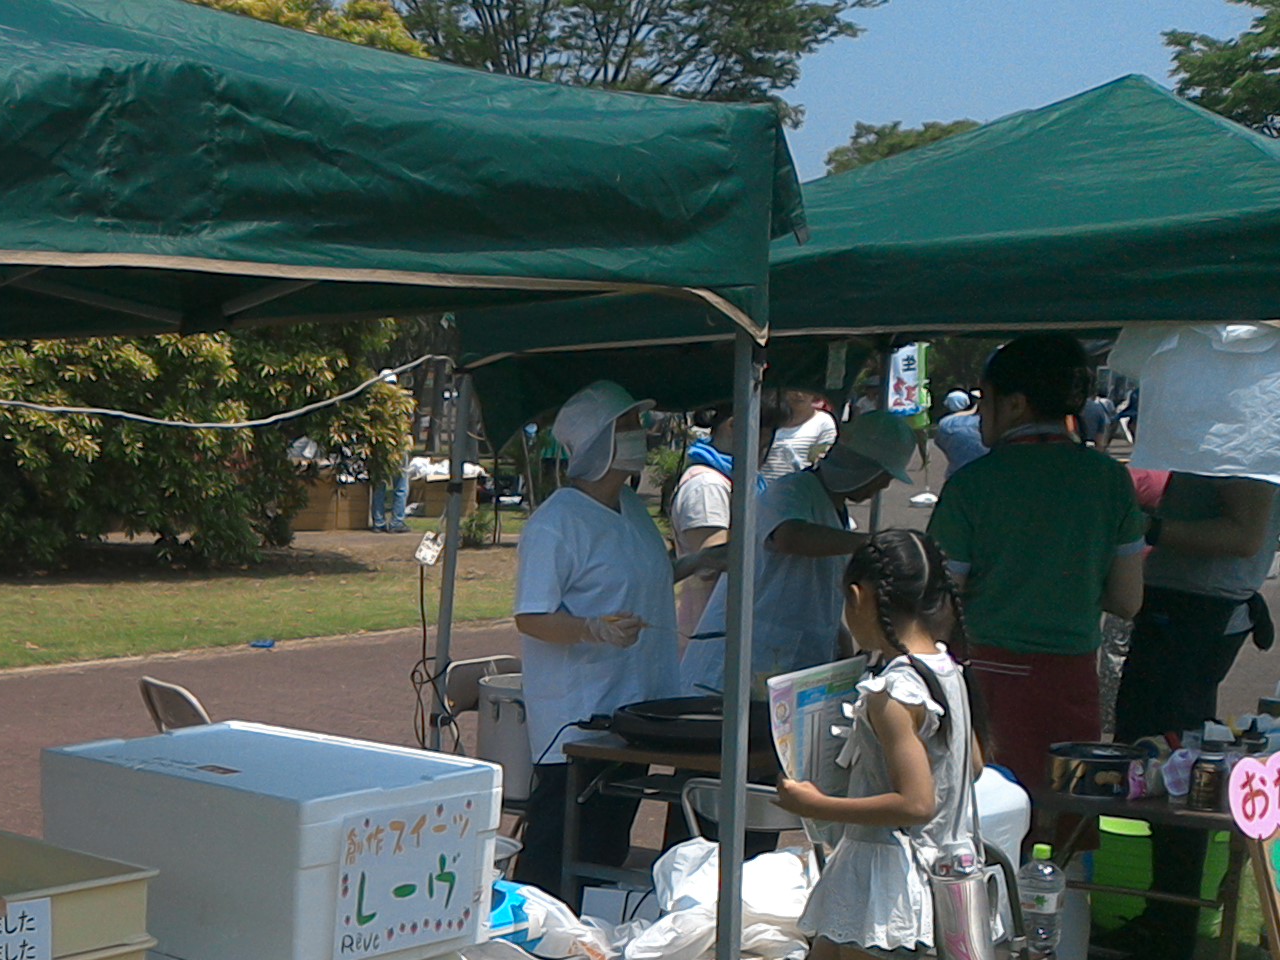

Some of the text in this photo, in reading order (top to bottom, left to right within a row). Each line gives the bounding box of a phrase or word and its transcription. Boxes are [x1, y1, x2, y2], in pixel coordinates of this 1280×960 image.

[1239, 767, 1280, 823] お
[345, 813, 470, 866] 創作スイーツ
